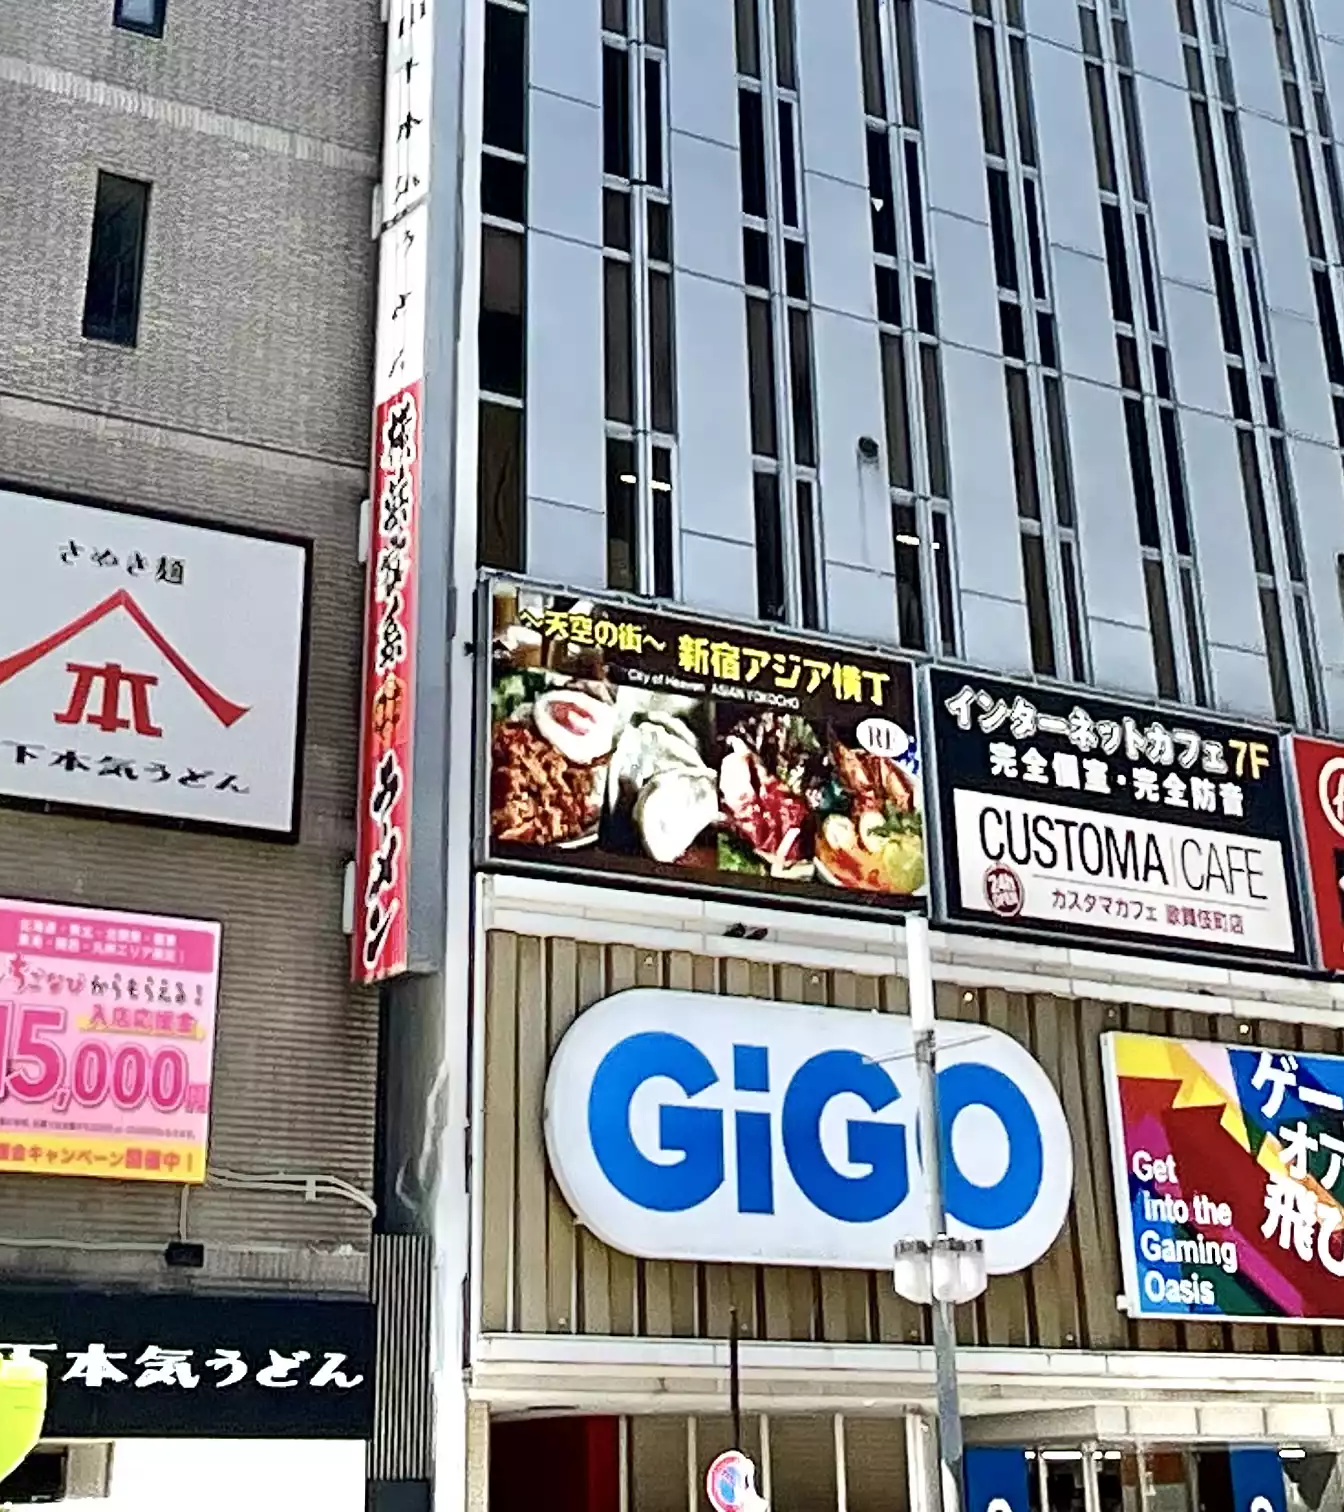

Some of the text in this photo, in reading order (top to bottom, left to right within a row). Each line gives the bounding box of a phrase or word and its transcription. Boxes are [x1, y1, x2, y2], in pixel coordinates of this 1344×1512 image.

[57, 539, 188, 586] さぬき麺
[677, 634, 891, 708] 新宿アジア横丁
[1228, 739, 1270, 780] 7F
[978, 806, 1269, 901] CUSTOMA CAFE
[587, 1030, 1044, 1231] GiGO
[1132, 1151, 1177, 1184] Get
[1192, 1194, 1233, 1228] the
[1139, 1232, 1238, 1276] Gaming
[1144, 1271, 1216, 1306] Oasis
